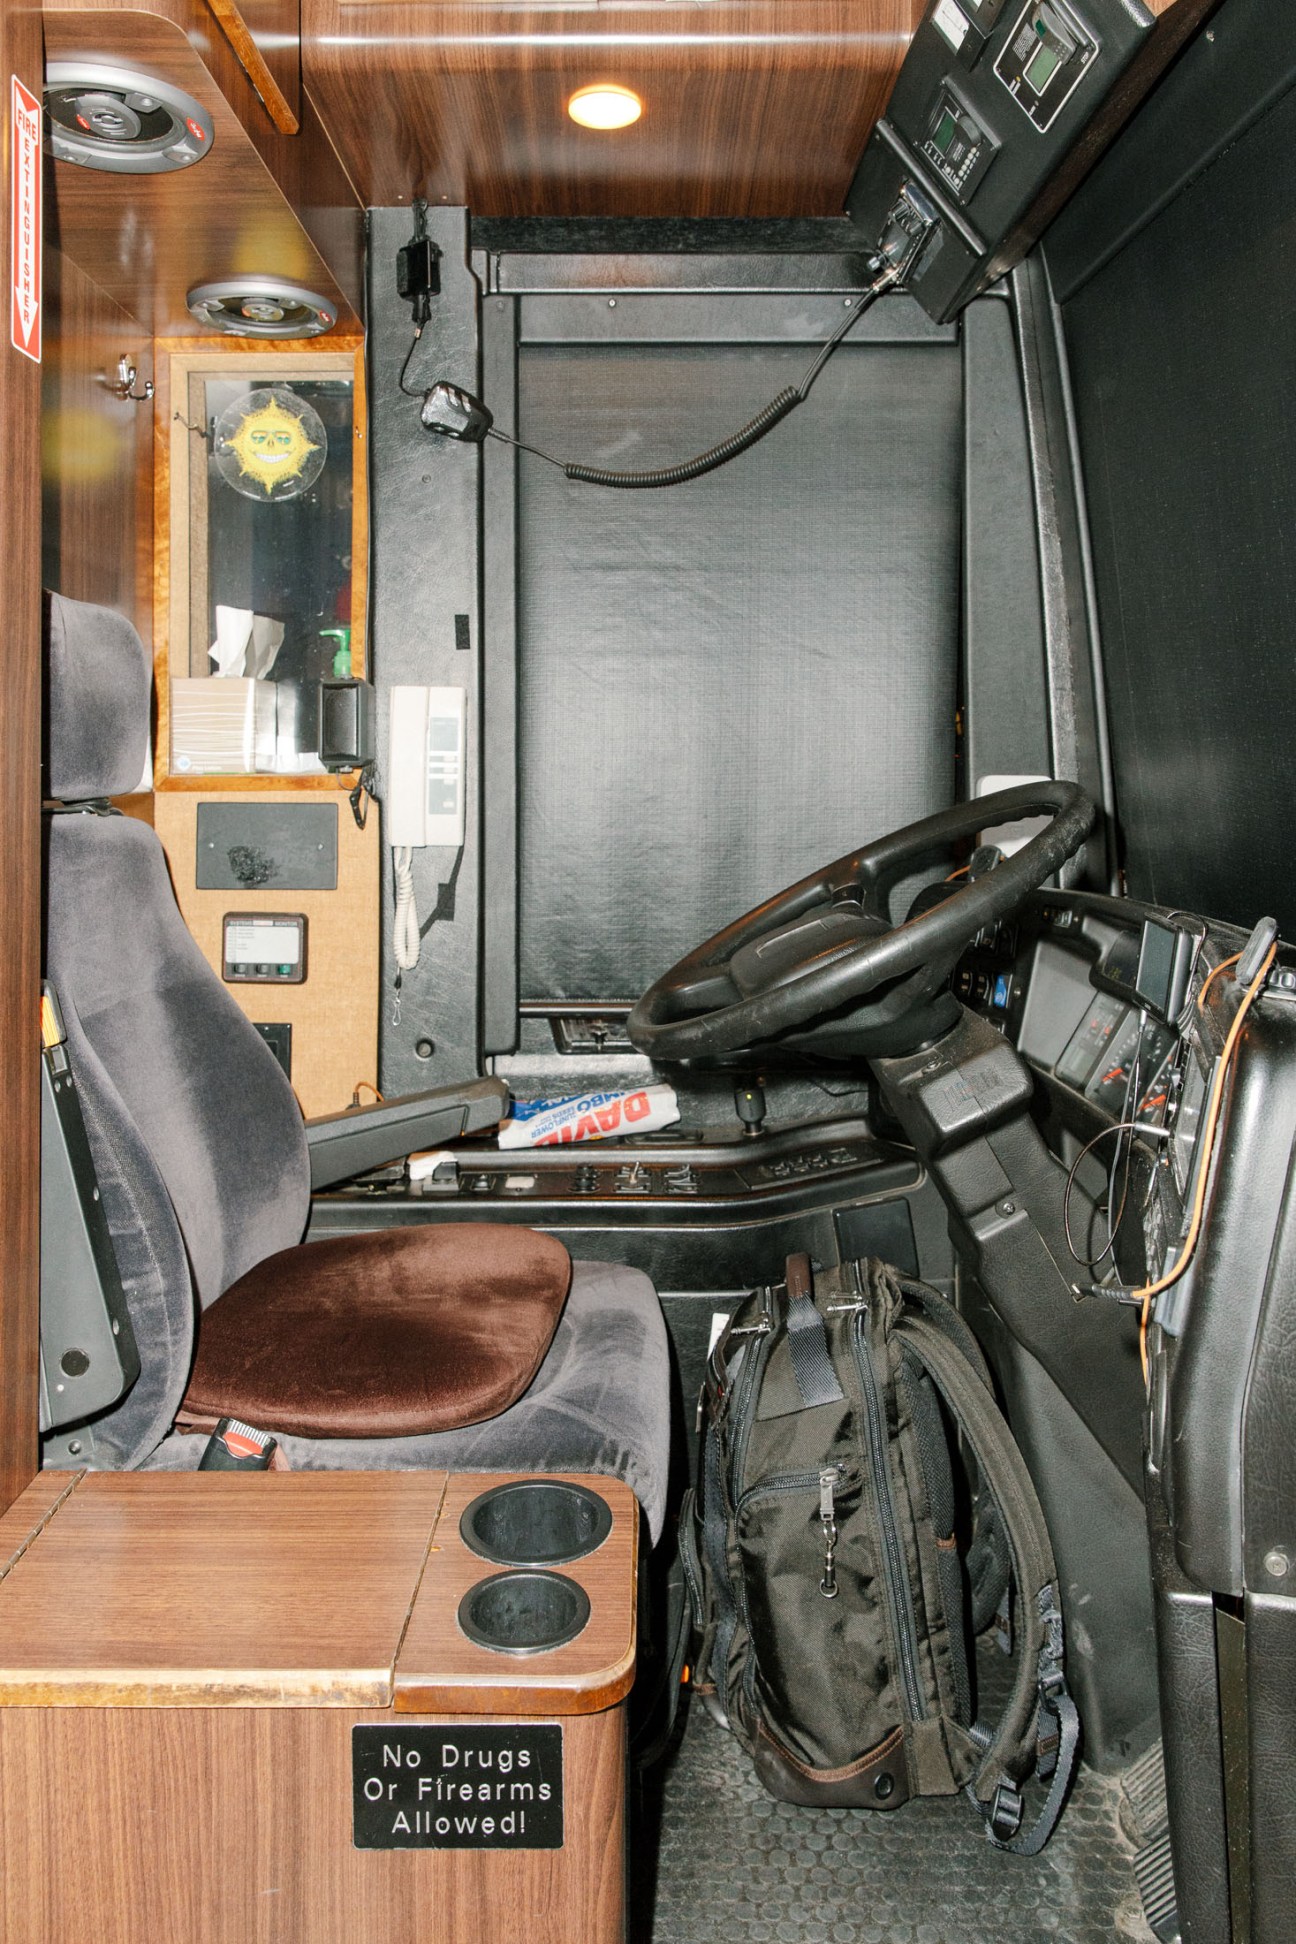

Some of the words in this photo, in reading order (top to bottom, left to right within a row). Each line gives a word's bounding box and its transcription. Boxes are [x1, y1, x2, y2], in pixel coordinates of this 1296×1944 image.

[17, 107, 37, 142] FIRE
[23, 137, 31, 325] EXTINGUISHER
[531, 1113, 576, 1138] SUNFLOWER
[383, 1744, 421, 1768] No
[441, 1744, 531, 1773] Drugs
[363, 1777, 398, 1801] Or
[418, 1777, 552, 1801] Firearms
[391, 1810, 526, 1835] Allowed!
